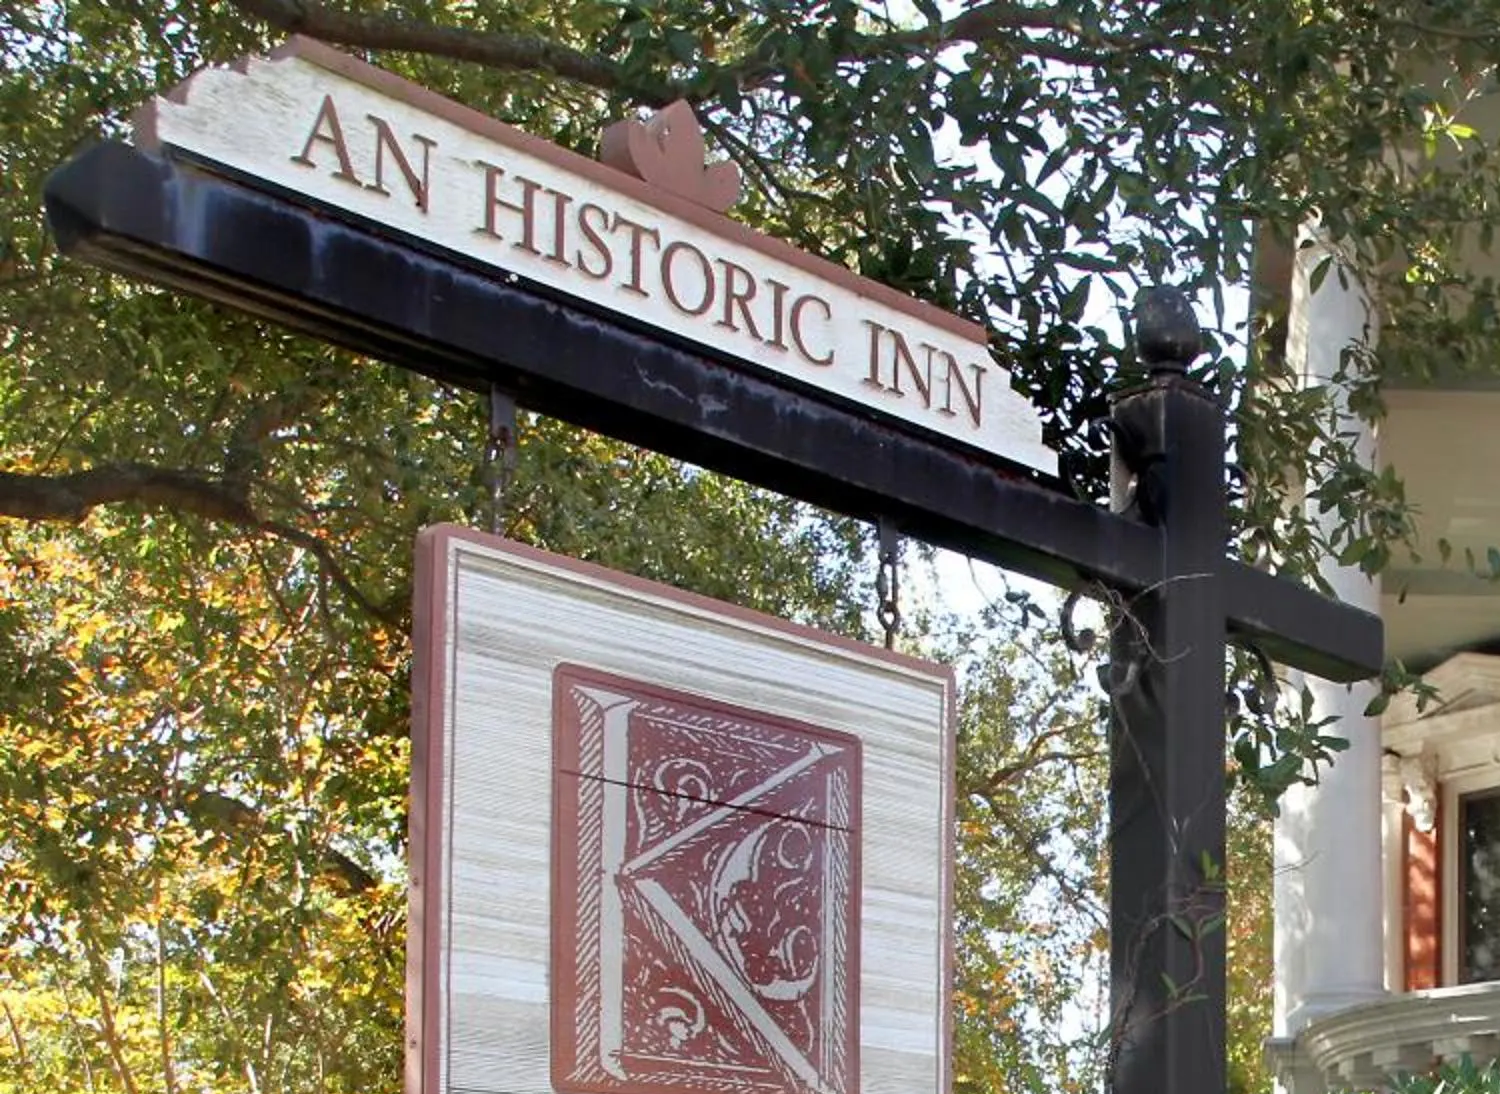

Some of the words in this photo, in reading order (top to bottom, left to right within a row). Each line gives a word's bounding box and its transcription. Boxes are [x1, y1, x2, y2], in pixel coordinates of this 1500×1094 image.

[290, 94, 438, 213] AN
[471, 159, 835, 367] HISTORIC
[861, 319, 986, 429] INN
